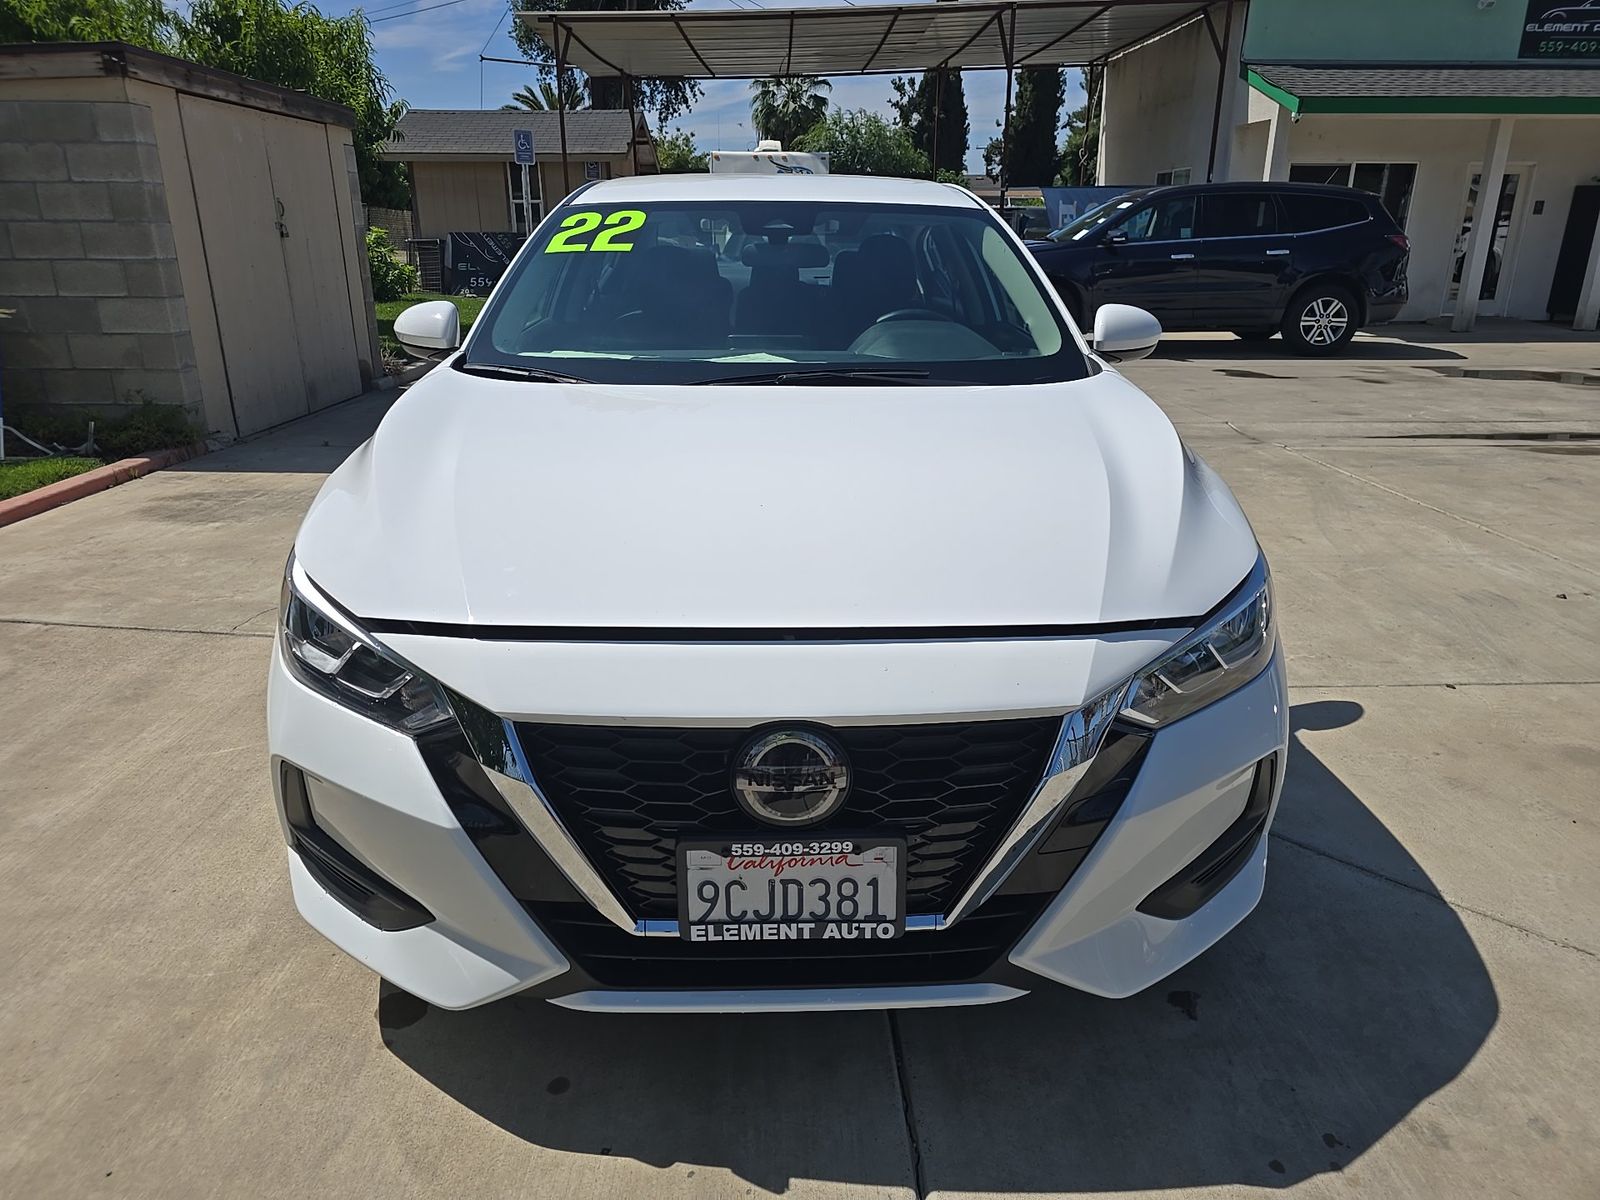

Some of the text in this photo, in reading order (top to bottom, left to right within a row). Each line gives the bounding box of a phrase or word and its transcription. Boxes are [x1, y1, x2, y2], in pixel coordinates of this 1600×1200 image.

[1526, 23, 1590, 32] ELEMENT
[544, 210, 647, 254] 22
[747, 771, 835, 788] NISSAN
[730, 841, 854, 856] 559-409-3299
[726, 854, 864, 876] California
[696, 878, 888, 922] 9CJD381
[690, 922, 896, 942] ELEMENT AUTO
